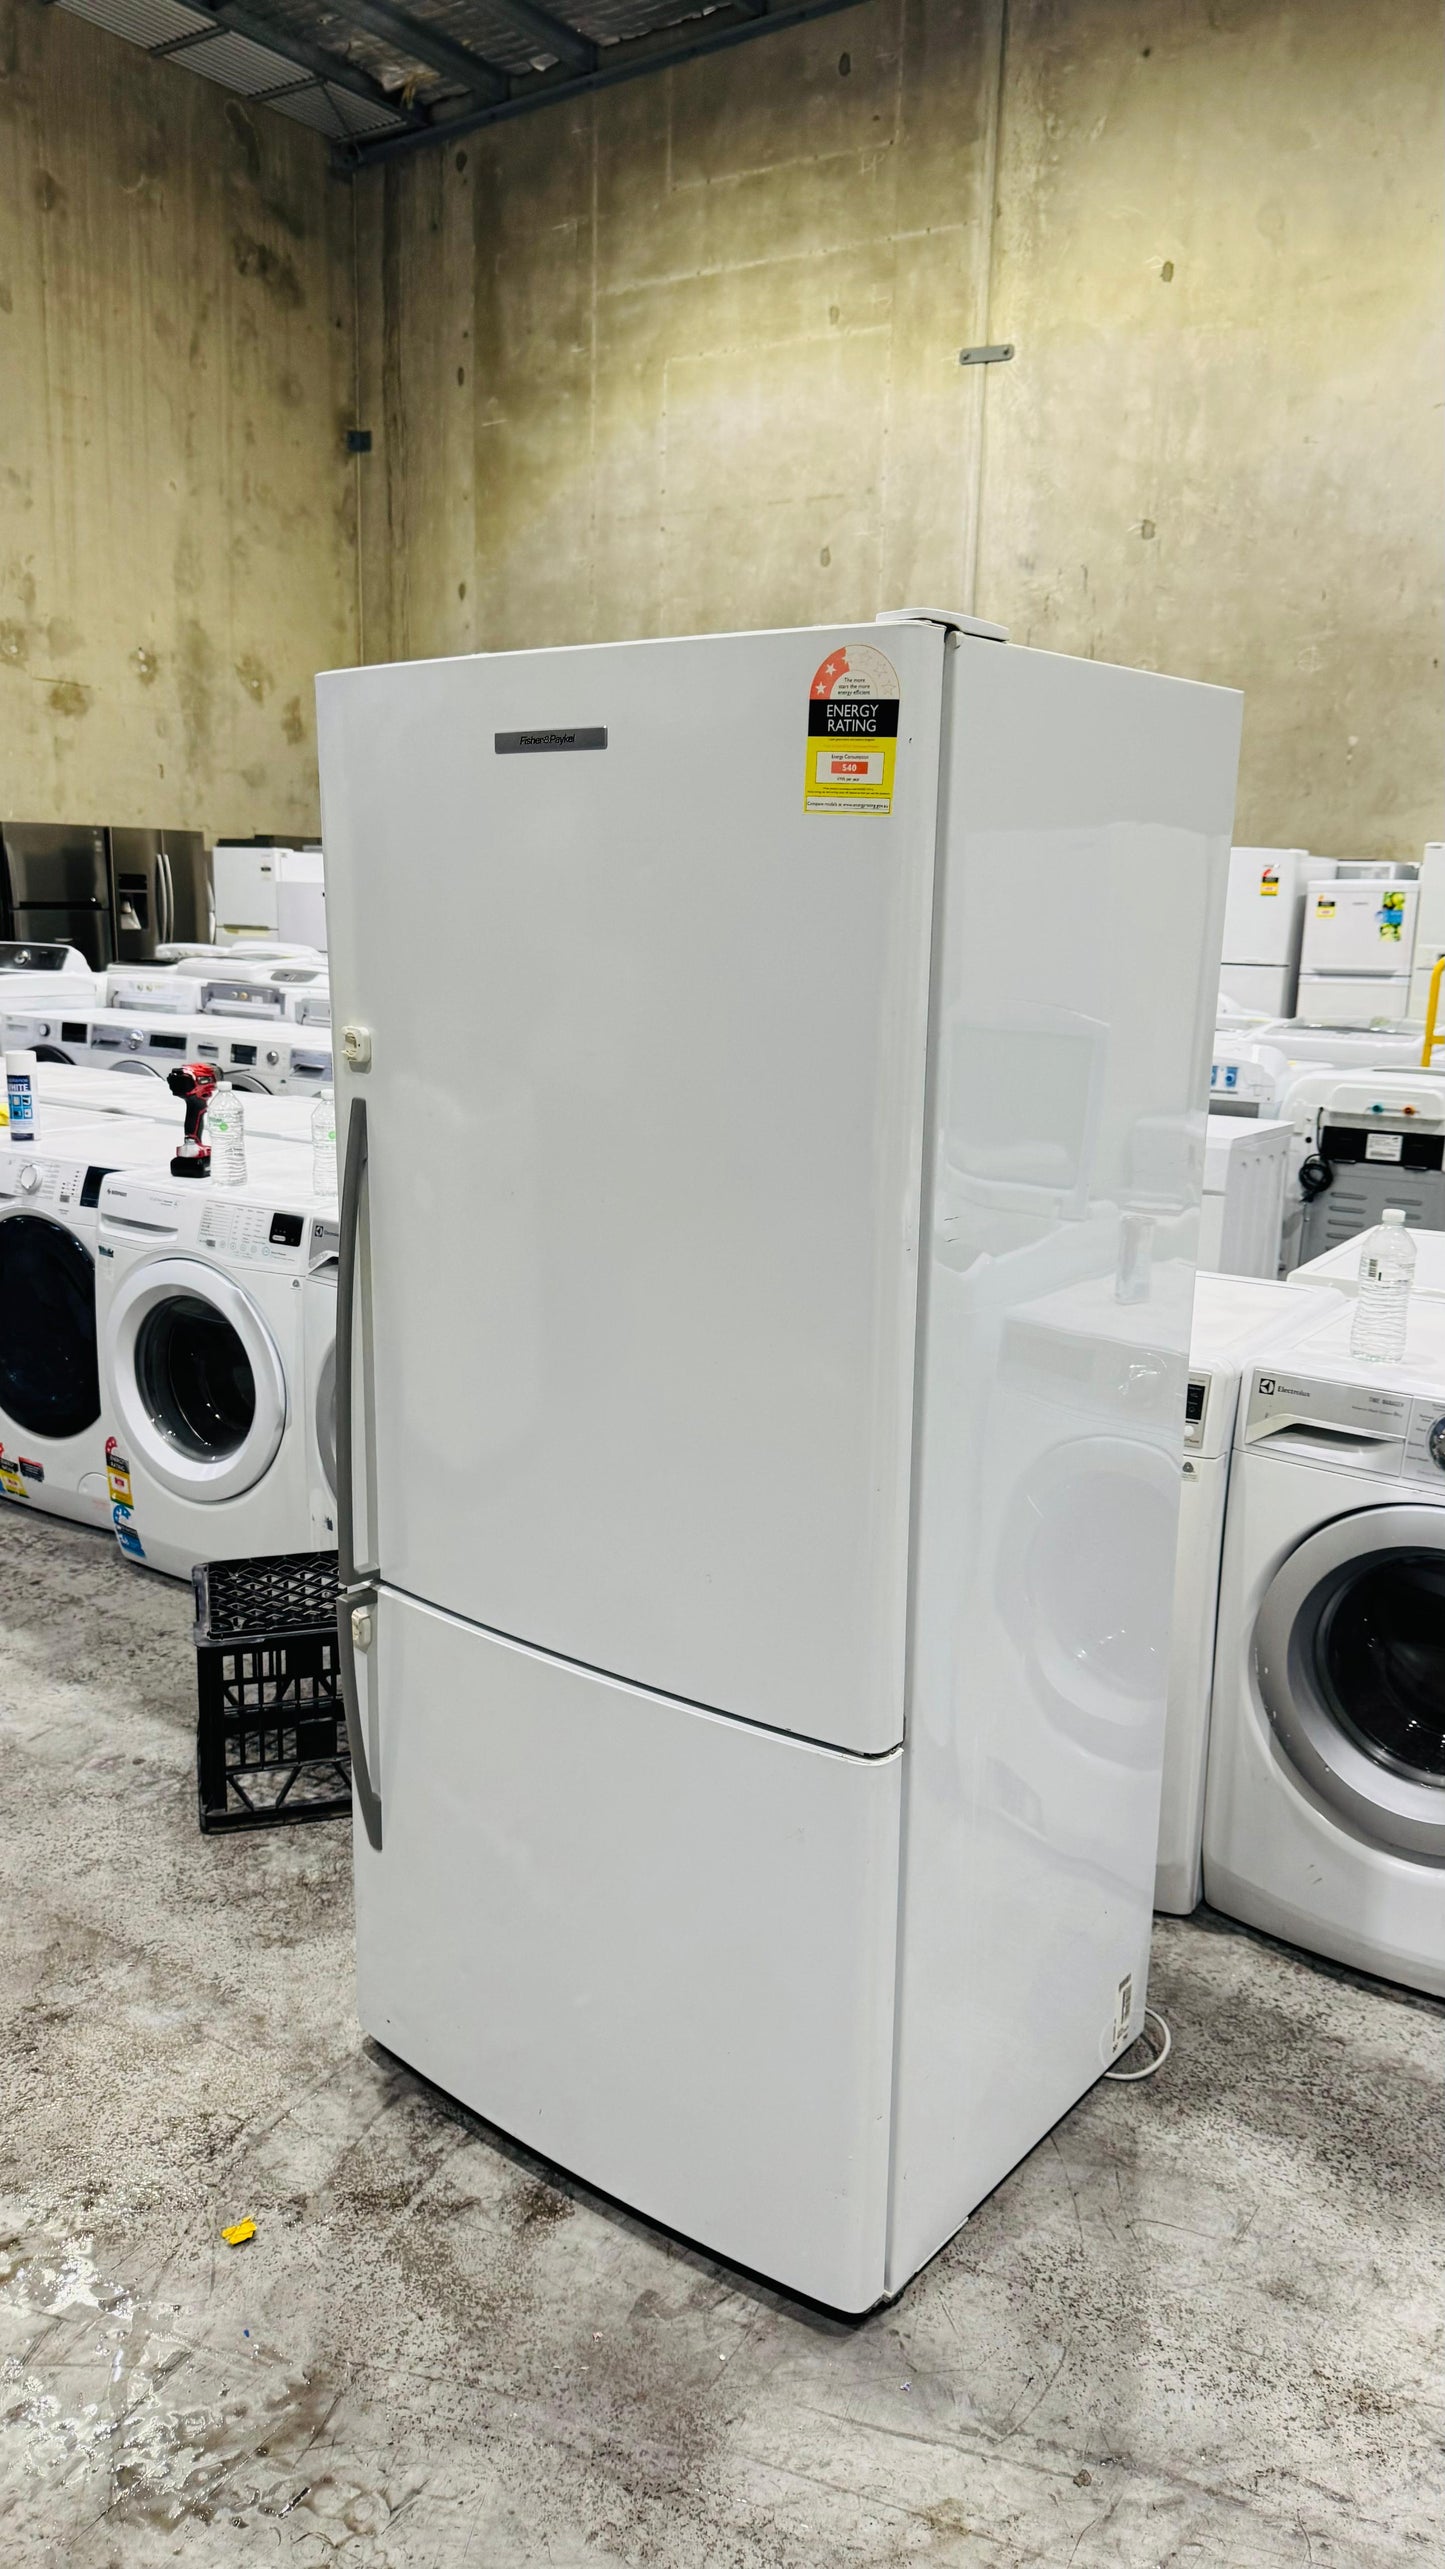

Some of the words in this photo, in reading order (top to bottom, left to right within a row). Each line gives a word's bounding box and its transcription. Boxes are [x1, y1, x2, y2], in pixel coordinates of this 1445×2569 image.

[826, 704, 880, 717] ENERGY
[827, 719, 877, 732] RATING
[842, 763, 857, 772] 540
[1277, 1386, 1310, 1397] Electrolux
